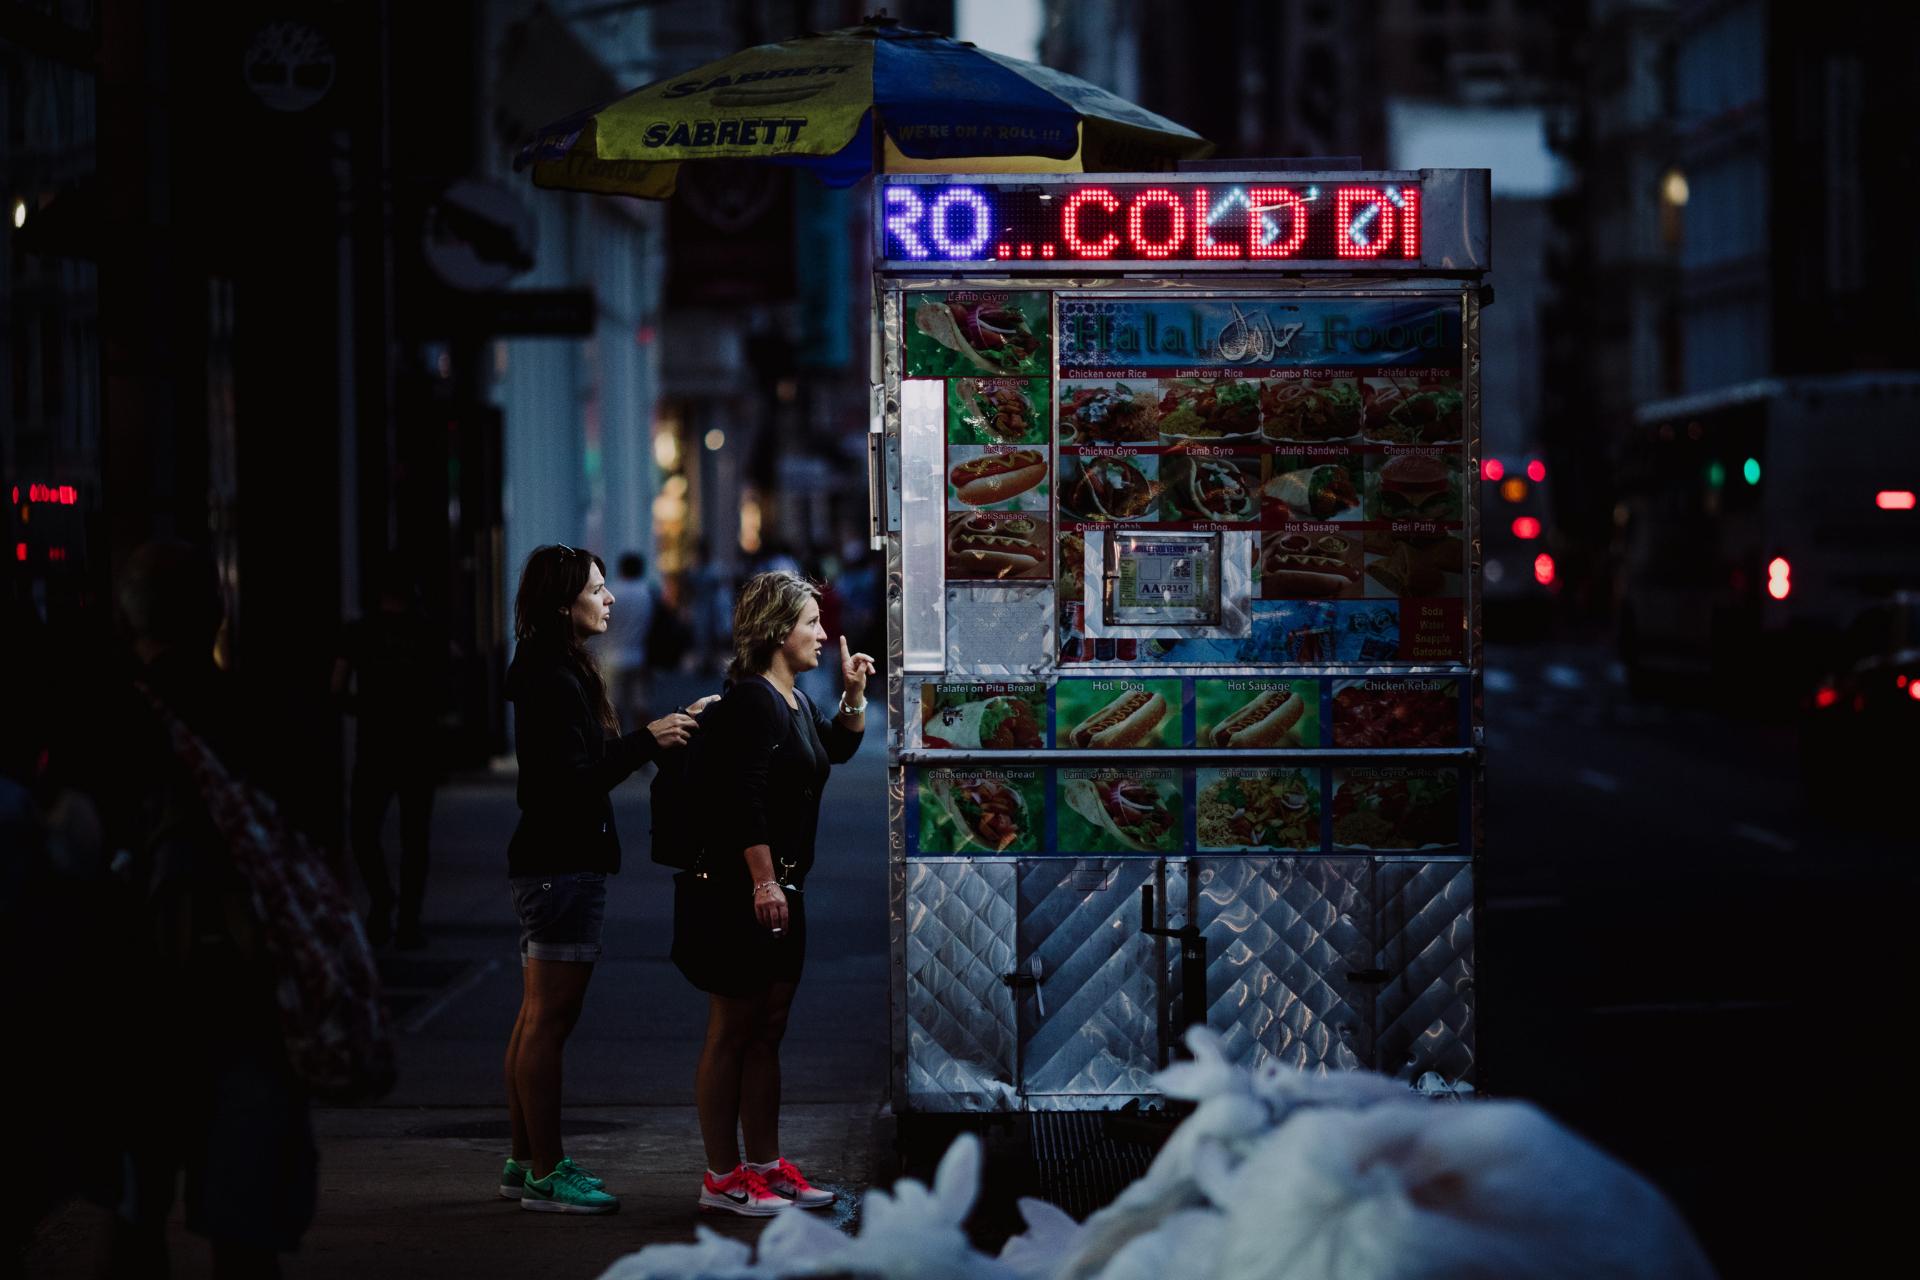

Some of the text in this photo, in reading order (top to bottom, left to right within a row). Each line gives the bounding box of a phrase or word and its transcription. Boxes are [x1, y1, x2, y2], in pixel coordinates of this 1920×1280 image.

[660, 63, 855, 98] SABRETT
[641, 116, 808, 148] SABRETT
[899, 124, 949, 141] WE'RE
[955, 125, 977, 137] ON
[982, 126, 992, 137] A
[998, 126, 1036, 139] ROLL
[948, 292, 1009, 303] Lamb Gyro
[1073, 310, 1202, 354] Halal
[1320, 309, 1447, 353] Food
[1069, 369, 1147, 379] Chicken over Rice
[1175, 369, 1199, 378] Lamb
[1224, 369, 1243, 378] Rice
[1269, 369, 1354, 379] Combo Rice Platter
[1377, 368, 1407, 377] Falafel
[1431, 368, 1451, 377] Rice
[1078, 447, 1138, 458] Chicken Gyro
[1186, 447, 1234, 458] Lamb Gyro
[1275, 446, 1349, 456] Falafel Sandwich
[993, 513, 1028, 522] Sausage
[1284, 522, 1340, 534] Hot Sausage
[1391, 522, 1437, 534] Beef Patty
[936, 684, 968, 693] Falafel
[986, 684, 1005, 692] Pita
[1007, 684, 1036, 692] Bread
[1092, 680, 1145, 692] Hot Dog
[1227, 681, 1291, 693] Hot Sausage
[1364, 681, 1441, 691] Chicken Kebab
[928, 770, 1035, 779] Chicken on Pita Bread
